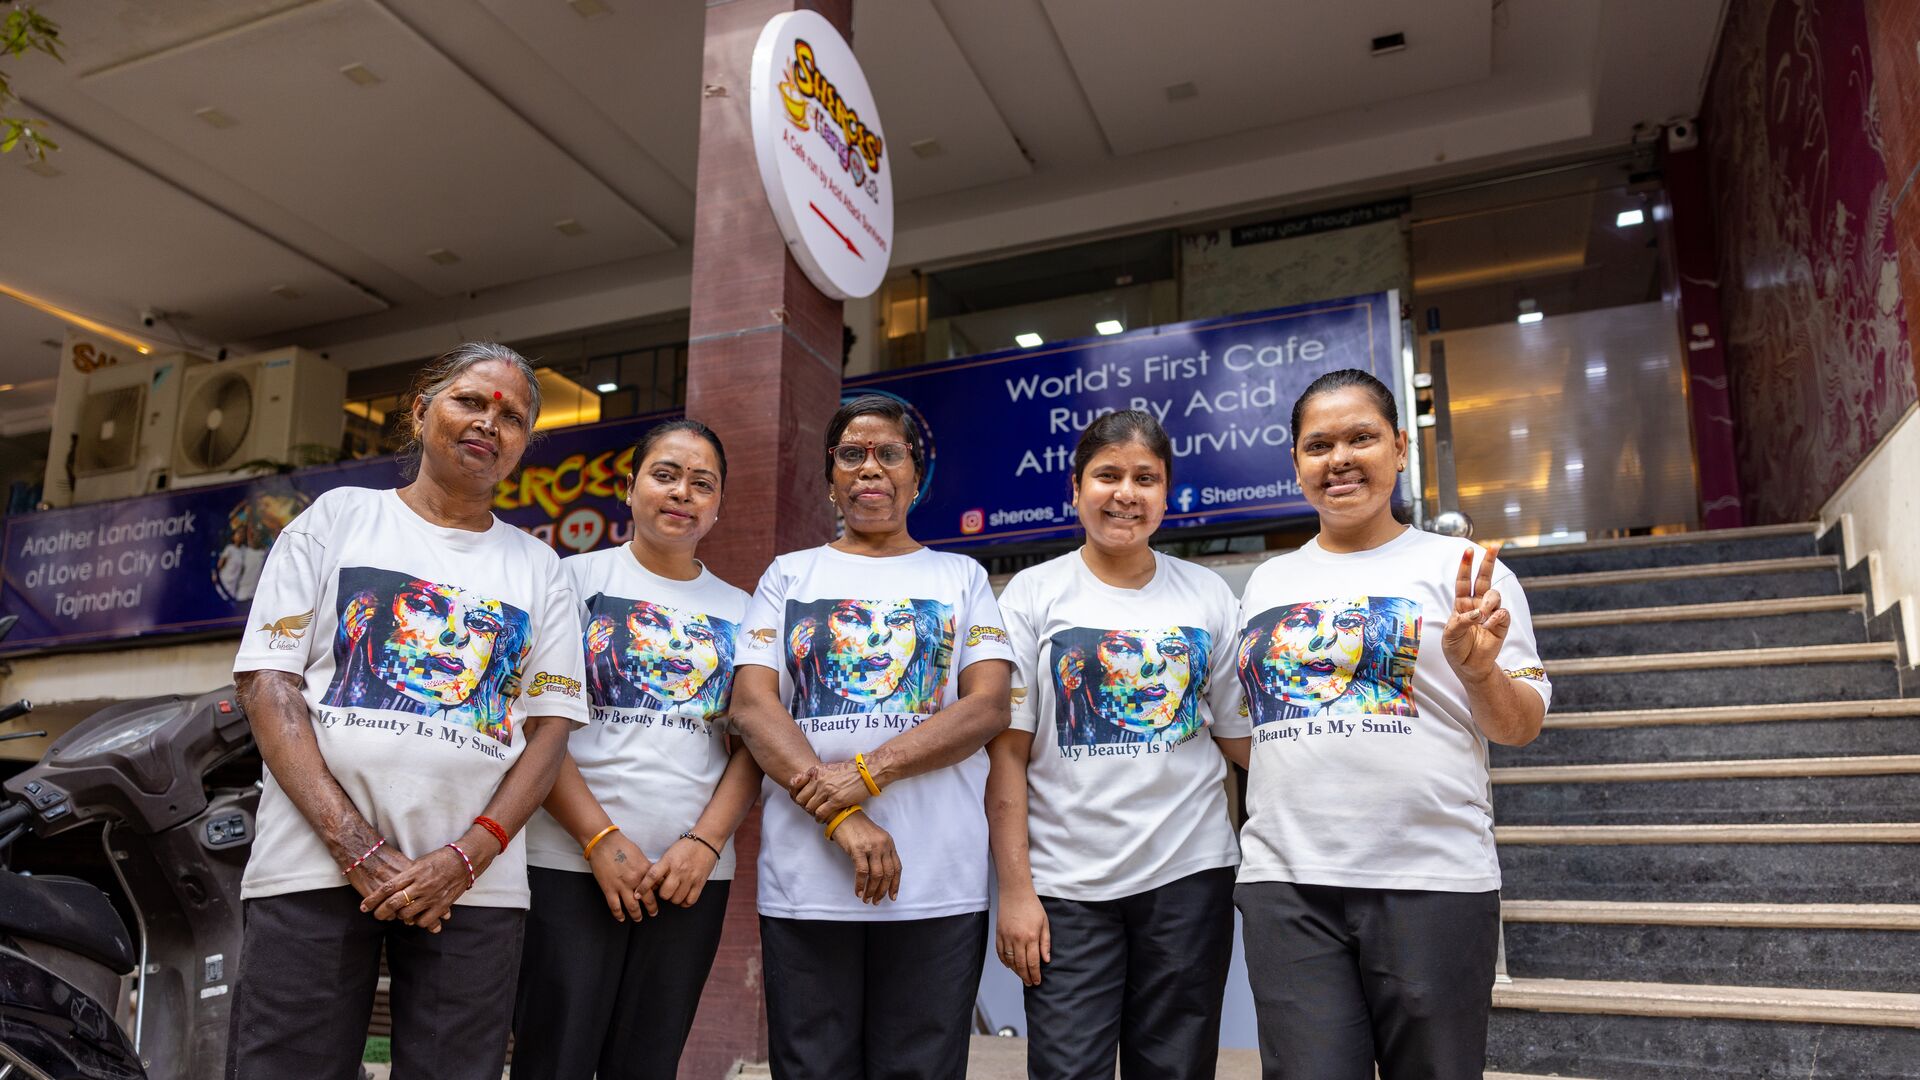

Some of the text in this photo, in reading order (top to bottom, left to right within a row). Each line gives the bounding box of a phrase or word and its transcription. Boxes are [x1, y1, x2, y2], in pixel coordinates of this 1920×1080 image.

[783, 128, 788, 142] A
[1006, 336, 1326, 402] World's First Cafe
[1130, 397, 1173, 427] By
[1184, 380, 1276, 417] Acid
[1015, 423, 1293, 477] Att urvivo
[1201, 479, 1303, 505] SheroesHa
[989, 501, 1078, 527] sheroes_ha
[20, 510, 197, 559] Another Landmark
[25, 543, 184, 589] of Love in City of
[55, 583, 143, 620] Tajmahal
[317, 709, 506, 761] My Beauty Is My Smile
[592, 708, 610, 725] My
[661, 714, 674, 728] Is
[678, 717, 700, 734] My
[811, 716, 860, 733] Beauty
[865, 714, 879, 729] Is
[883, 714, 909, 733] My
[1259, 726, 1301, 743] Beauty
[1307, 721, 1322, 736] Is
[1328, 719, 1356, 738] My
[1362, 719, 1412, 735] Smile
[1060, 745, 1082, 761] My
[1087, 742, 1141, 759] Beauty
[1146, 742, 1160, 754] Is
